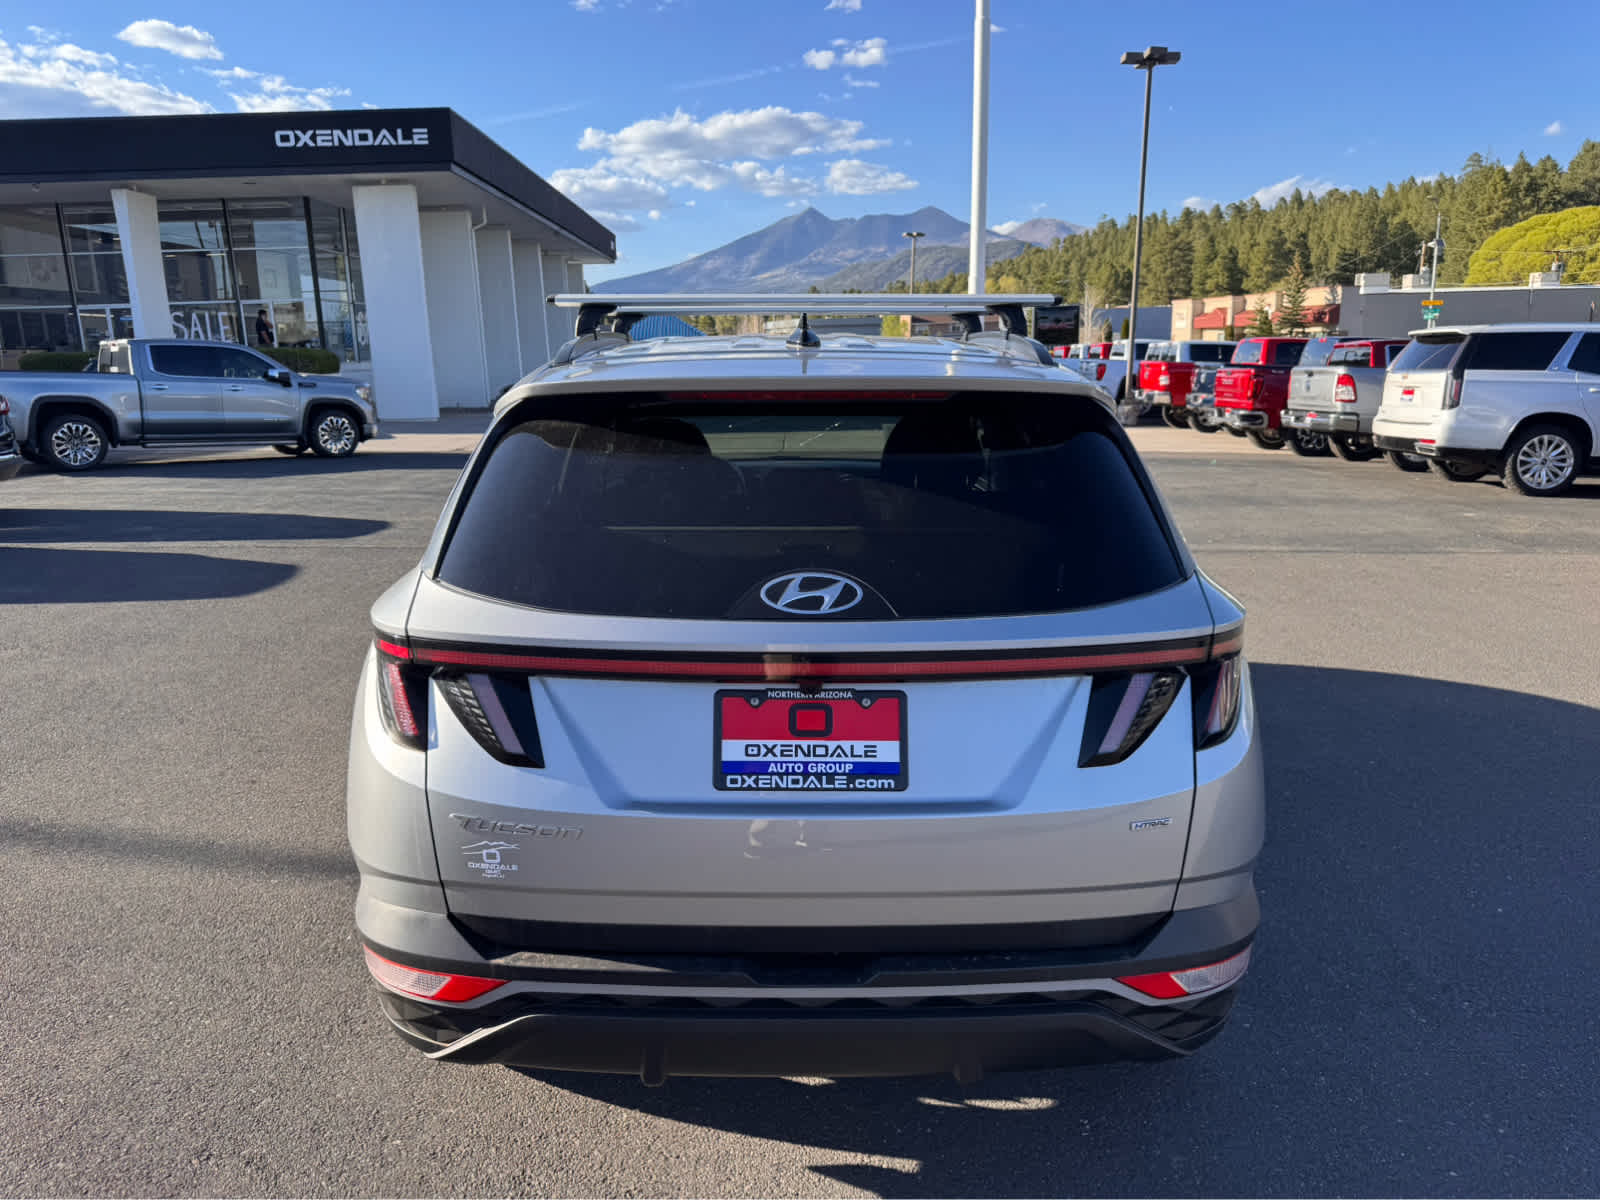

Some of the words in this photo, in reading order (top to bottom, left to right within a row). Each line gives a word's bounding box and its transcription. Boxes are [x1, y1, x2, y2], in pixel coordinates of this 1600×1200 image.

[274, 127, 429, 148] OXENDALE
[744, 743, 877, 759] OXENDALE
[767, 763, 804, 774] AUTO
[807, 763, 854, 774] GROUP
[726, 774, 895, 790] OXENDALE.com
